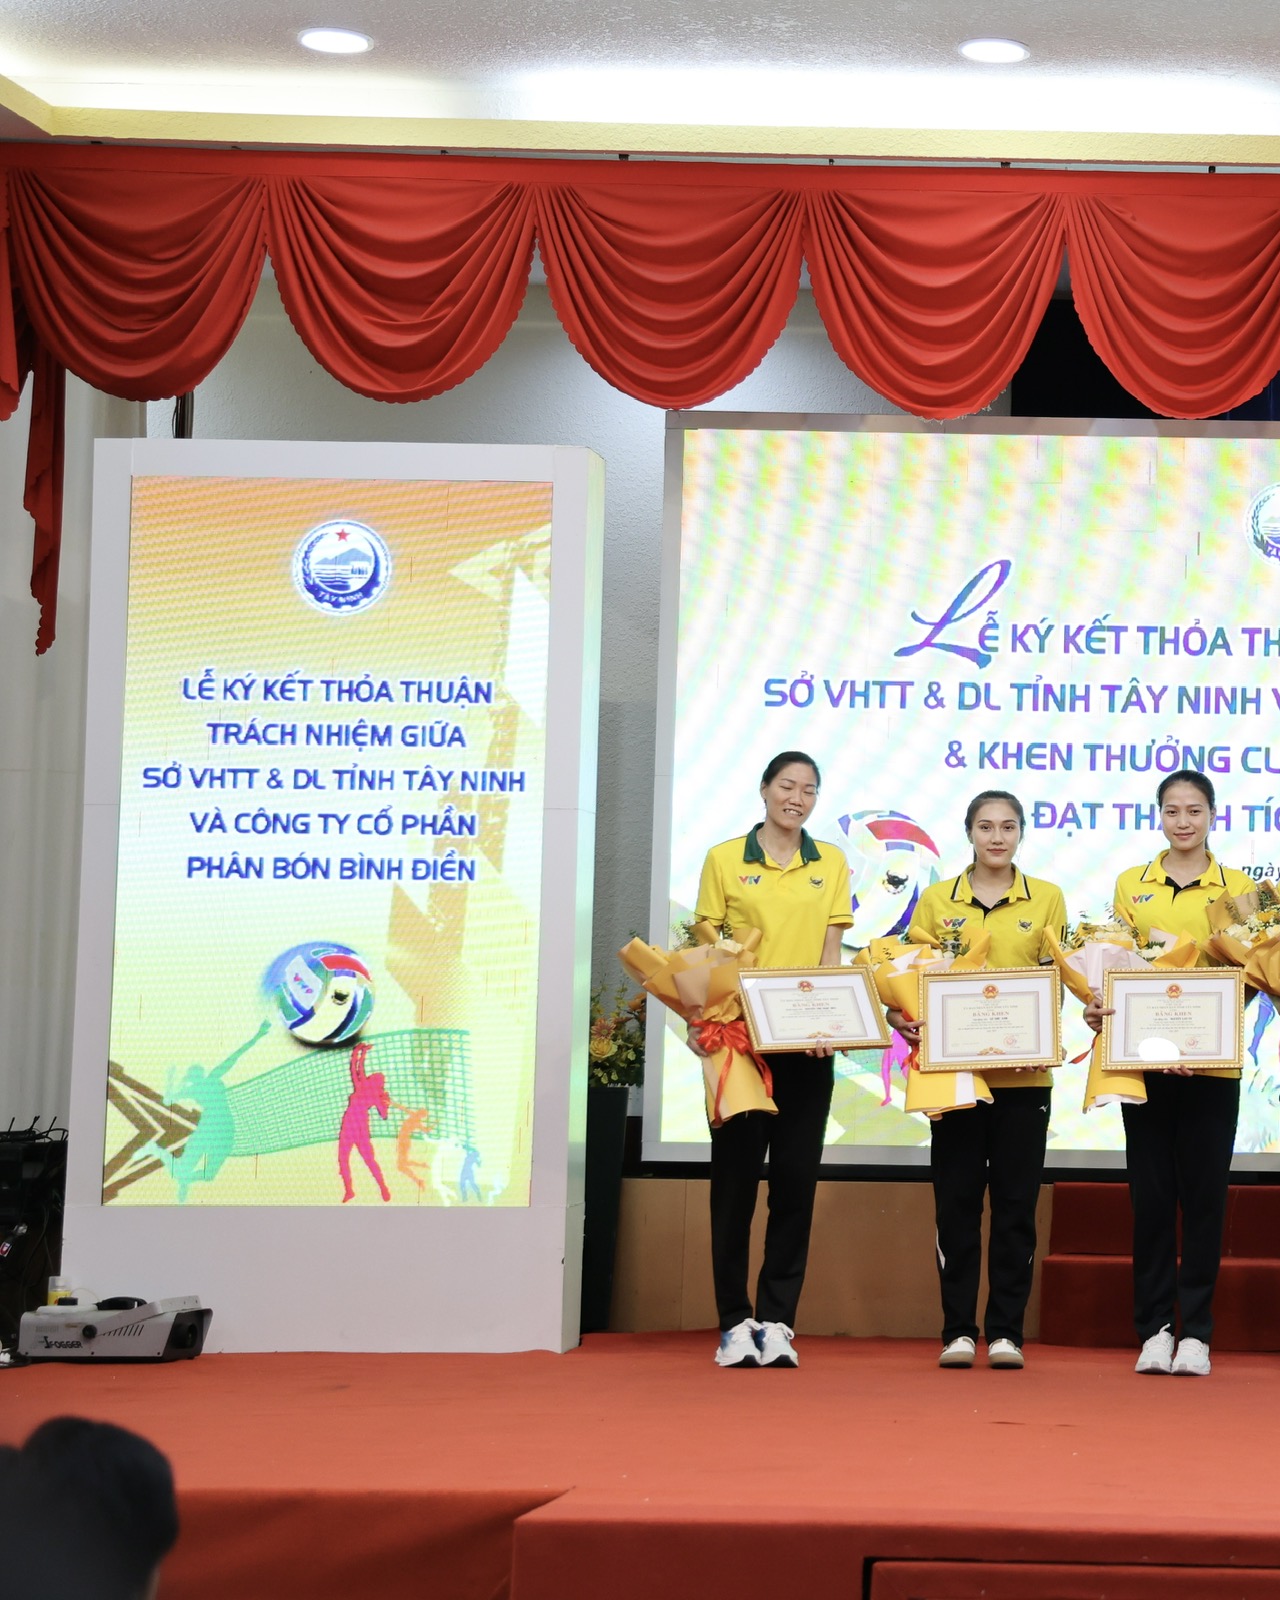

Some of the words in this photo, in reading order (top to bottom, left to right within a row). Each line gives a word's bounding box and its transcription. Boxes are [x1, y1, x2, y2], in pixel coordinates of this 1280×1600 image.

[894, 559, 1011, 669] LỄ
[1011, 617, 1055, 654] KÝ
[1063, 613, 1128, 655] KẾT
[1136, 618, 1233, 657] THỎA
[183, 668, 215, 700] LỄ
[223, 673, 257, 700] KÝ
[263, 670, 314, 702] KẾT
[320, 674, 394, 702] THỎA
[400, 676, 493, 709] THUẬN
[764, 670, 815, 708] SỞ
[823, 680, 915, 709] VHTT
[923, 681, 946, 709] &
[958, 682, 1001, 711] DL
[1010, 674, 1091, 712] TỈNH
[1100, 677, 1169, 714] TÂY
[1177, 685, 1261, 716] NINH
[206, 718, 297, 746] TRÁCH
[305, 718, 392, 752] NHIỆM
[400, 720, 467, 748] GIỮA
[944, 740, 967, 768] &
[978, 741, 1073, 771] KHEN
[1083, 735, 1231, 773] THƯỞNG
[143, 761, 182, 788] SỞ
[189, 768, 260, 789] VHTT
[266, 768, 284, 789] &
[293, 769, 326, 790] DL
[332, 763, 394, 791] TỈNH
[403, 765, 454, 791] TÂY
[461, 771, 525, 792] NINH
[190, 806, 227, 834] VÀ
[234, 807, 310, 835] CÔNG
[318, 813, 351, 835] TY
[357, 804, 393, 836] CỔ
[401, 805, 476, 836] PHẦN
[1031, 800, 1104, 837] ĐẠT
[1112, 803, 1231, 832] THH
[187, 851, 264, 879] PHÂN
[273, 852, 330, 880] BÓN
[340, 852, 403, 880] BÌNH
[411, 850, 476, 881] ĐIỀN
[739, 875, 761, 885] VTV
[1132, 893, 1154, 904] VTV
